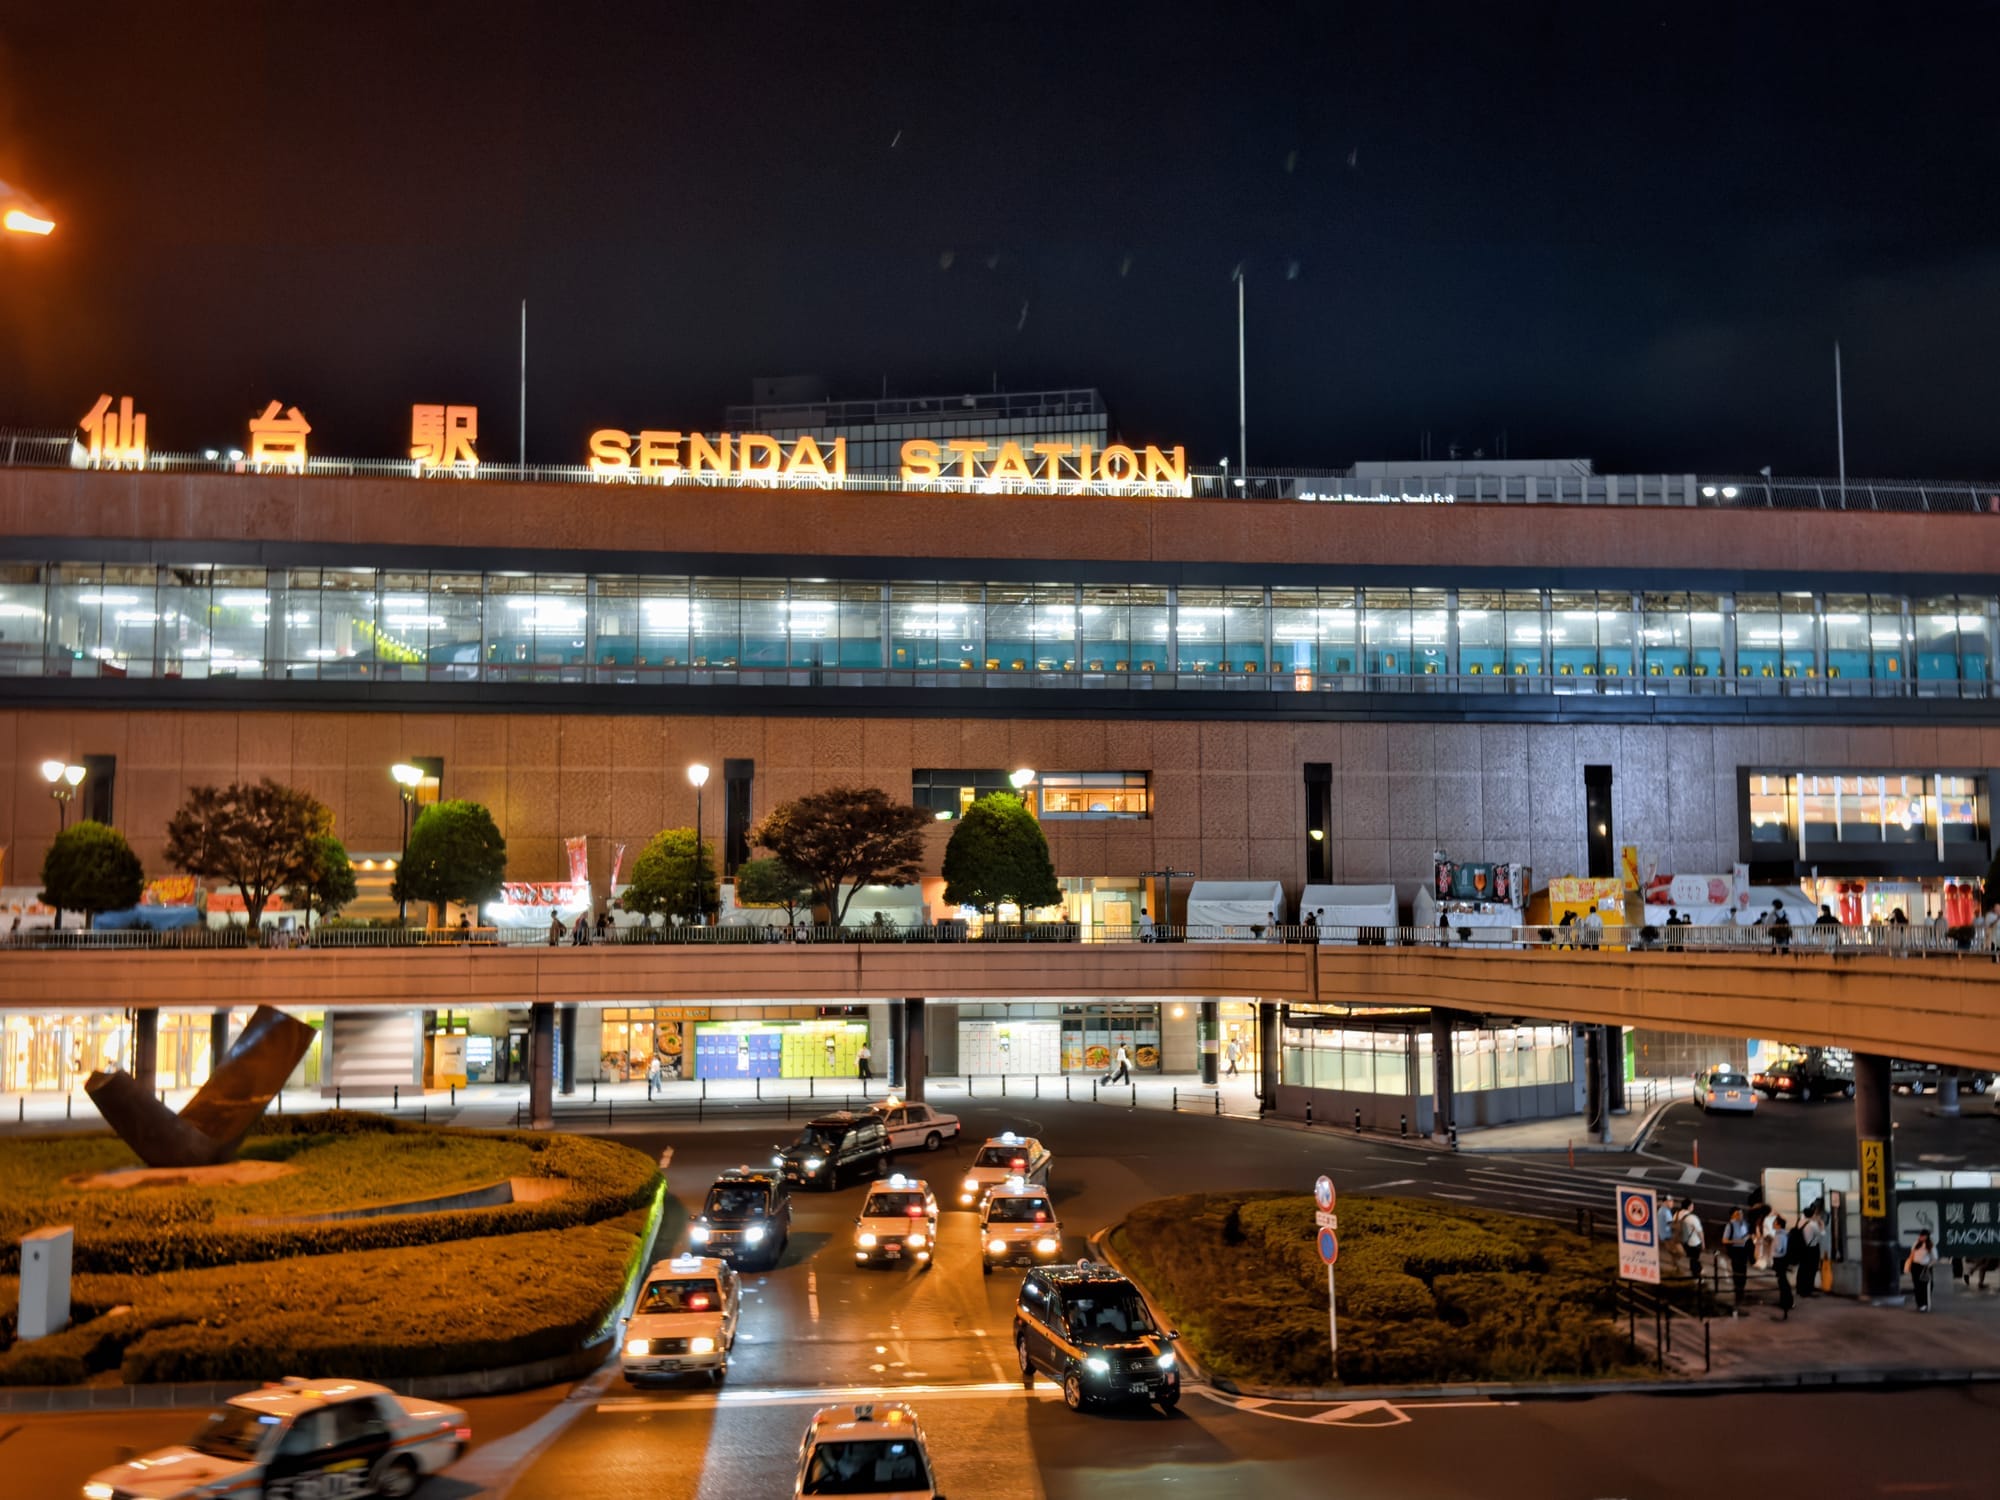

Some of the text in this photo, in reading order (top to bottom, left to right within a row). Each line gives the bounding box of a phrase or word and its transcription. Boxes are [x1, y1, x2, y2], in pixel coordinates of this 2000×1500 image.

[80, 393, 479, 466] 仙台駅
[589, 429, 1190, 491] SENDAI STATION
[1945, 1202, 2000, 1224] 喫煙
